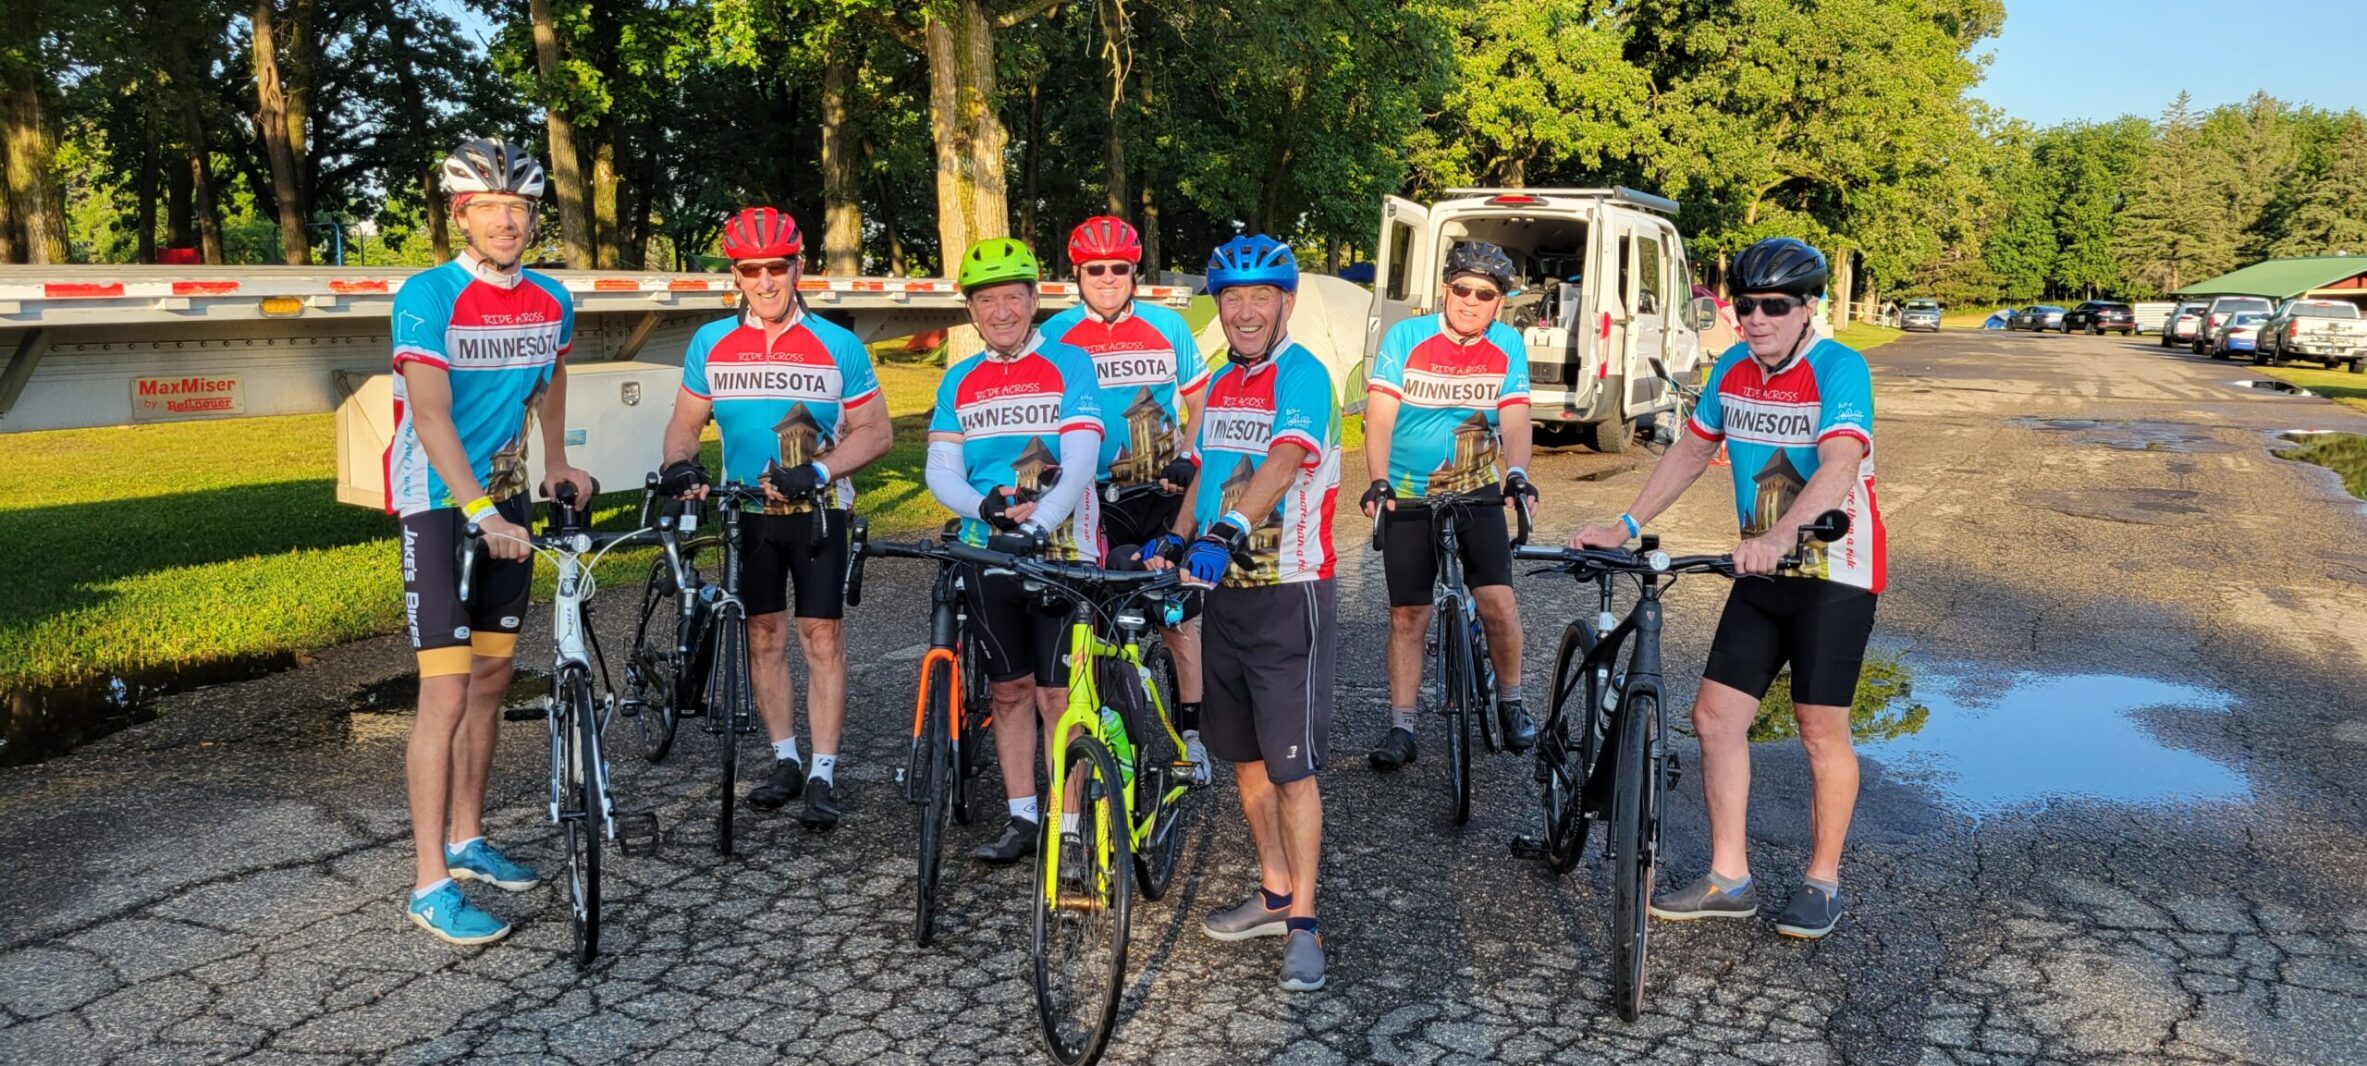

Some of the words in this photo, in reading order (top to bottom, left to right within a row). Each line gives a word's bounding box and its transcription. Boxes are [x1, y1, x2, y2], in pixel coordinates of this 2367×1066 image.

[481, 314, 513, 325] RIDE
[1109, 341, 1144, 351] ACROSS
[736, 352, 762, 361] RIDE
[139, 378, 236, 396] MaxMiser
[713, 371, 827, 393] MINNESOTA
[1002, 382, 1040, 395] ACROSS
[1762, 390, 1799, 402] ACROSS
[144, 399, 158, 409] by
